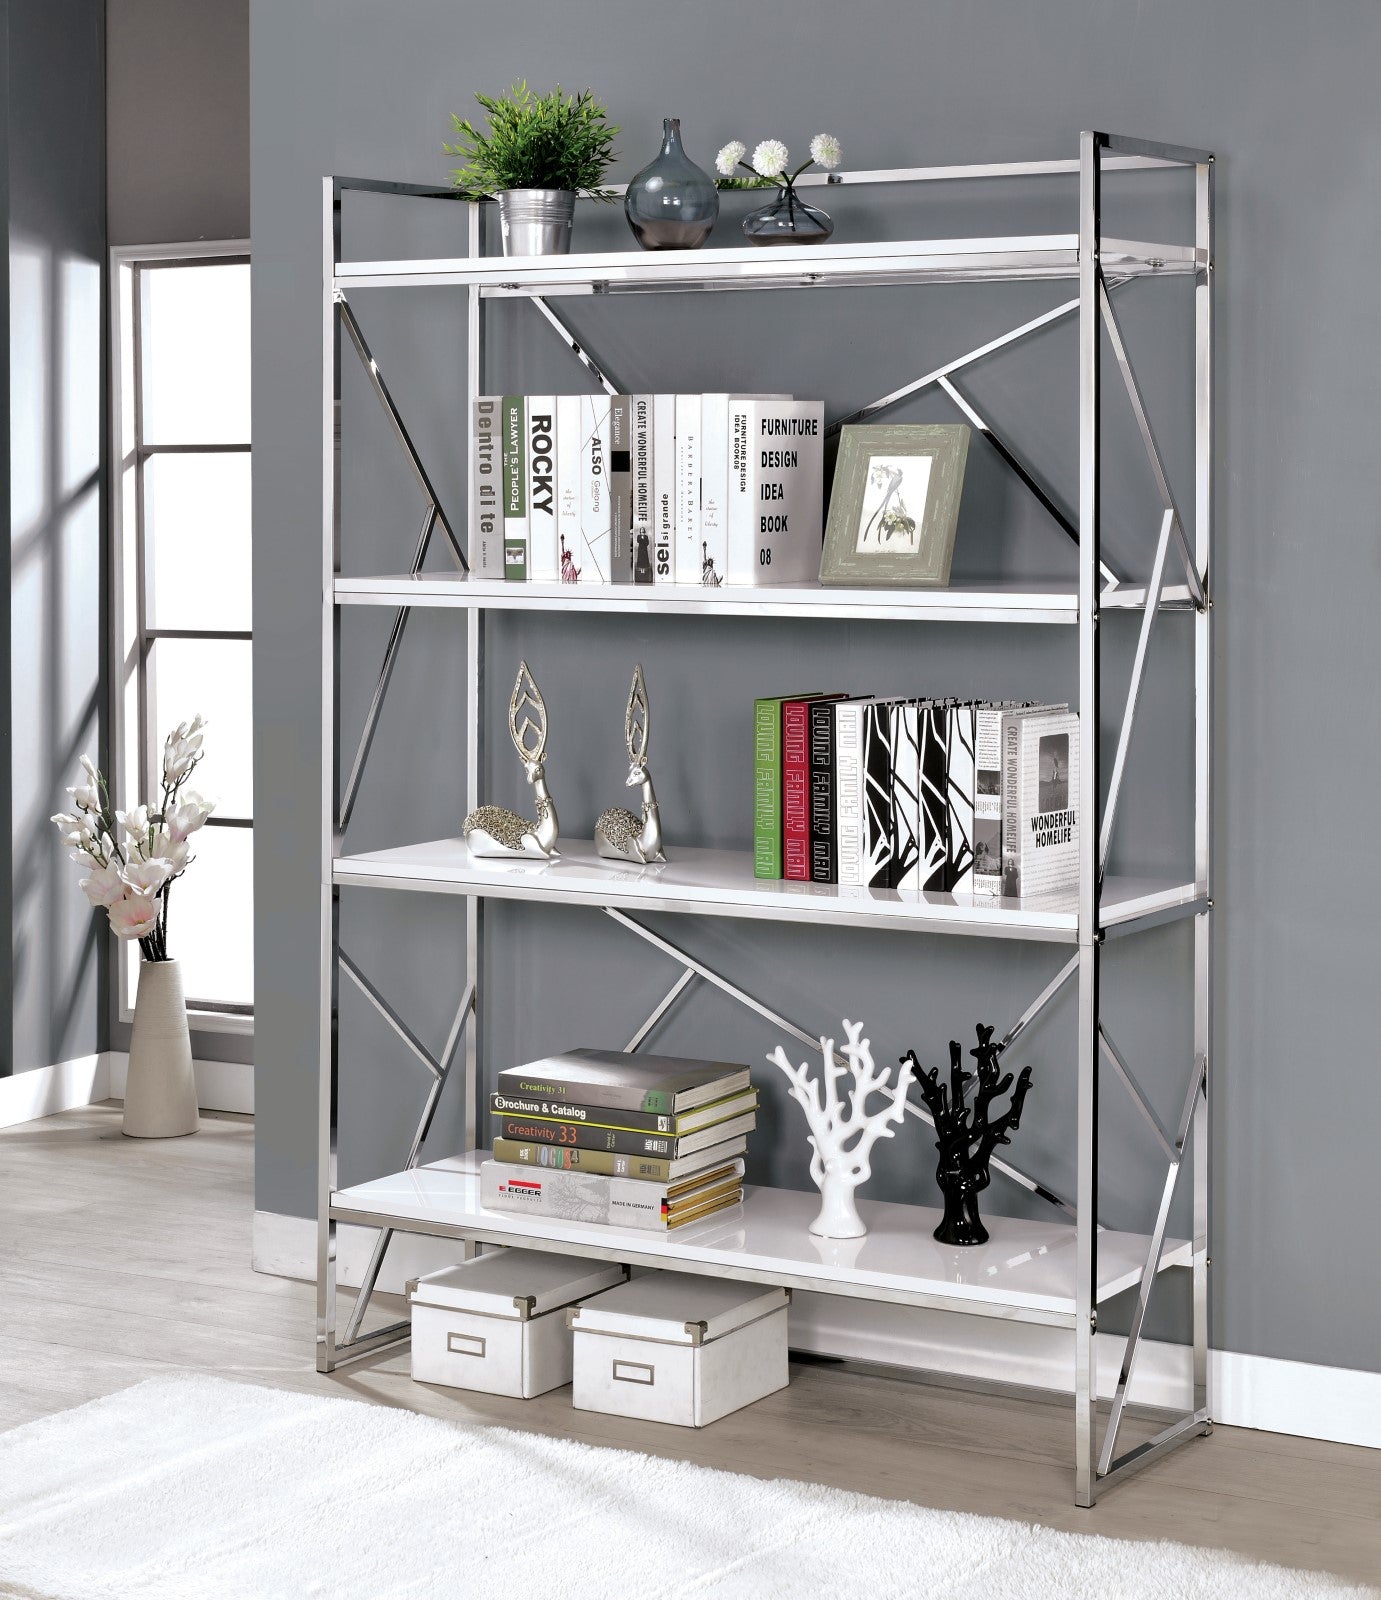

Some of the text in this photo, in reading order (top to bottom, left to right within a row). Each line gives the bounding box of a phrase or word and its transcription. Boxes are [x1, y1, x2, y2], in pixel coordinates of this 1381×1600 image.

[614, 407, 623, 445] Elegance
[761, 418, 818, 436] FURNITURE
[478, 401, 496, 534] Dentro di te
[510, 407, 519, 511] PEOPLE'S LAWYER
[532, 414, 553, 516] ROCKY
[591, 437, 602, 475] ALSO
[637, 400, 648, 522] CREATE WONDERFUL HOMELIFE
[761, 451, 798, 468] DESIGN
[760, 483, 784, 501] IDEA
[655, 543, 669, 575] sei
[662, 493, 671, 529] grande
[760, 515, 788, 533] BOOK
[760, 548, 772, 566] 08
[838, 709, 857, 749] MAN
[1006, 725, 1017, 756] CREATE
[755, 704, 775, 875] LOVING FAMILY MAN
[786, 705, 806, 878] LOVING FAMILY MAN
[812, 707, 831, 881] LOVING FAMILY MAN
[1006, 758, 1017, 810] WONDERFUL
[1006, 812, 1017, 854] HOMELIFE
[1031, 809, 1076, 833] WONDERFUL
[1035, 827, 1071, 849] HOMELIFE
[519, 1081, 556, 1095] Creativity
[494, 1096, 586, 1120] Brochure & Catalog
[507, 1123, 577, 1144] Creativity 33
[508, 1187, 542, 1197] EGGER
[631, 1202, 655, 1211] GERMANY
